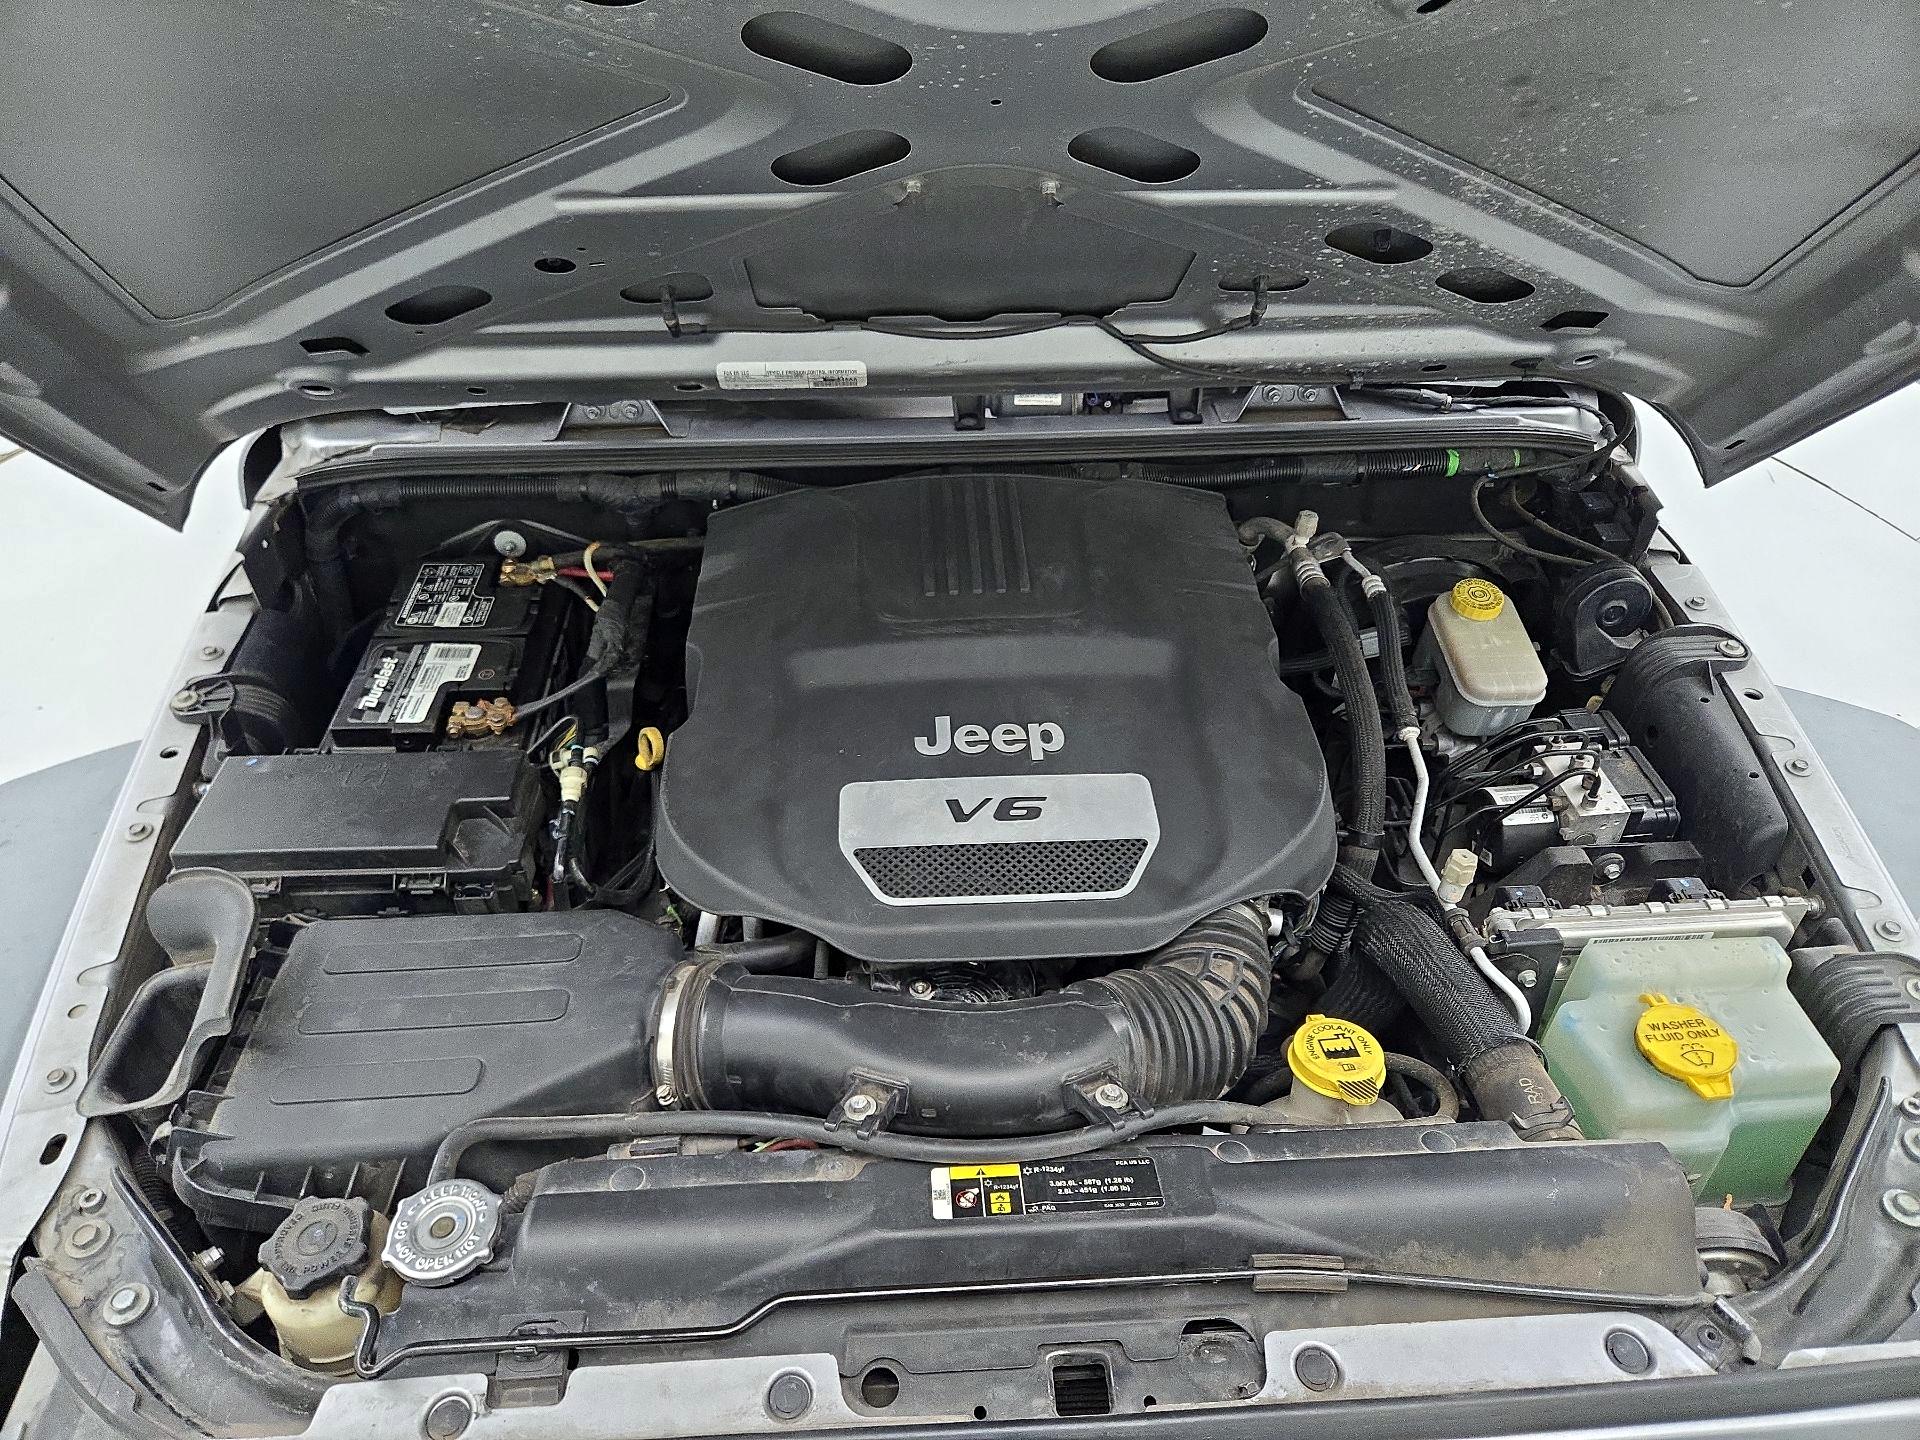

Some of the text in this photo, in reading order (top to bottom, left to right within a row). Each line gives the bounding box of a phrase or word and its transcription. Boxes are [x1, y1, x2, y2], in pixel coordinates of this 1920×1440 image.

[358, 656, 399, 710] Duralast
[914, 715, 1065, 761] Jeep
[945, 796, 1047, 823] V6
[1644, 1028, 1721, 1043] FLUID ONLY
[1646, 1018, 1707, 1032] WASHER
[1306, 1024, 1373, 1060] ENGINE COOLANT ONLY
[1033, 1165, 1065, 1174] R-1234yf
[420, 1184, 460, 1205] KEEP
[993, 1183, 1019, 1191] R-1234yf
[395, 1241, 416, 1263] NOT
[415, 1254, 455, 1271] OPEN
[455, 1232, 481, 1258] HOT
